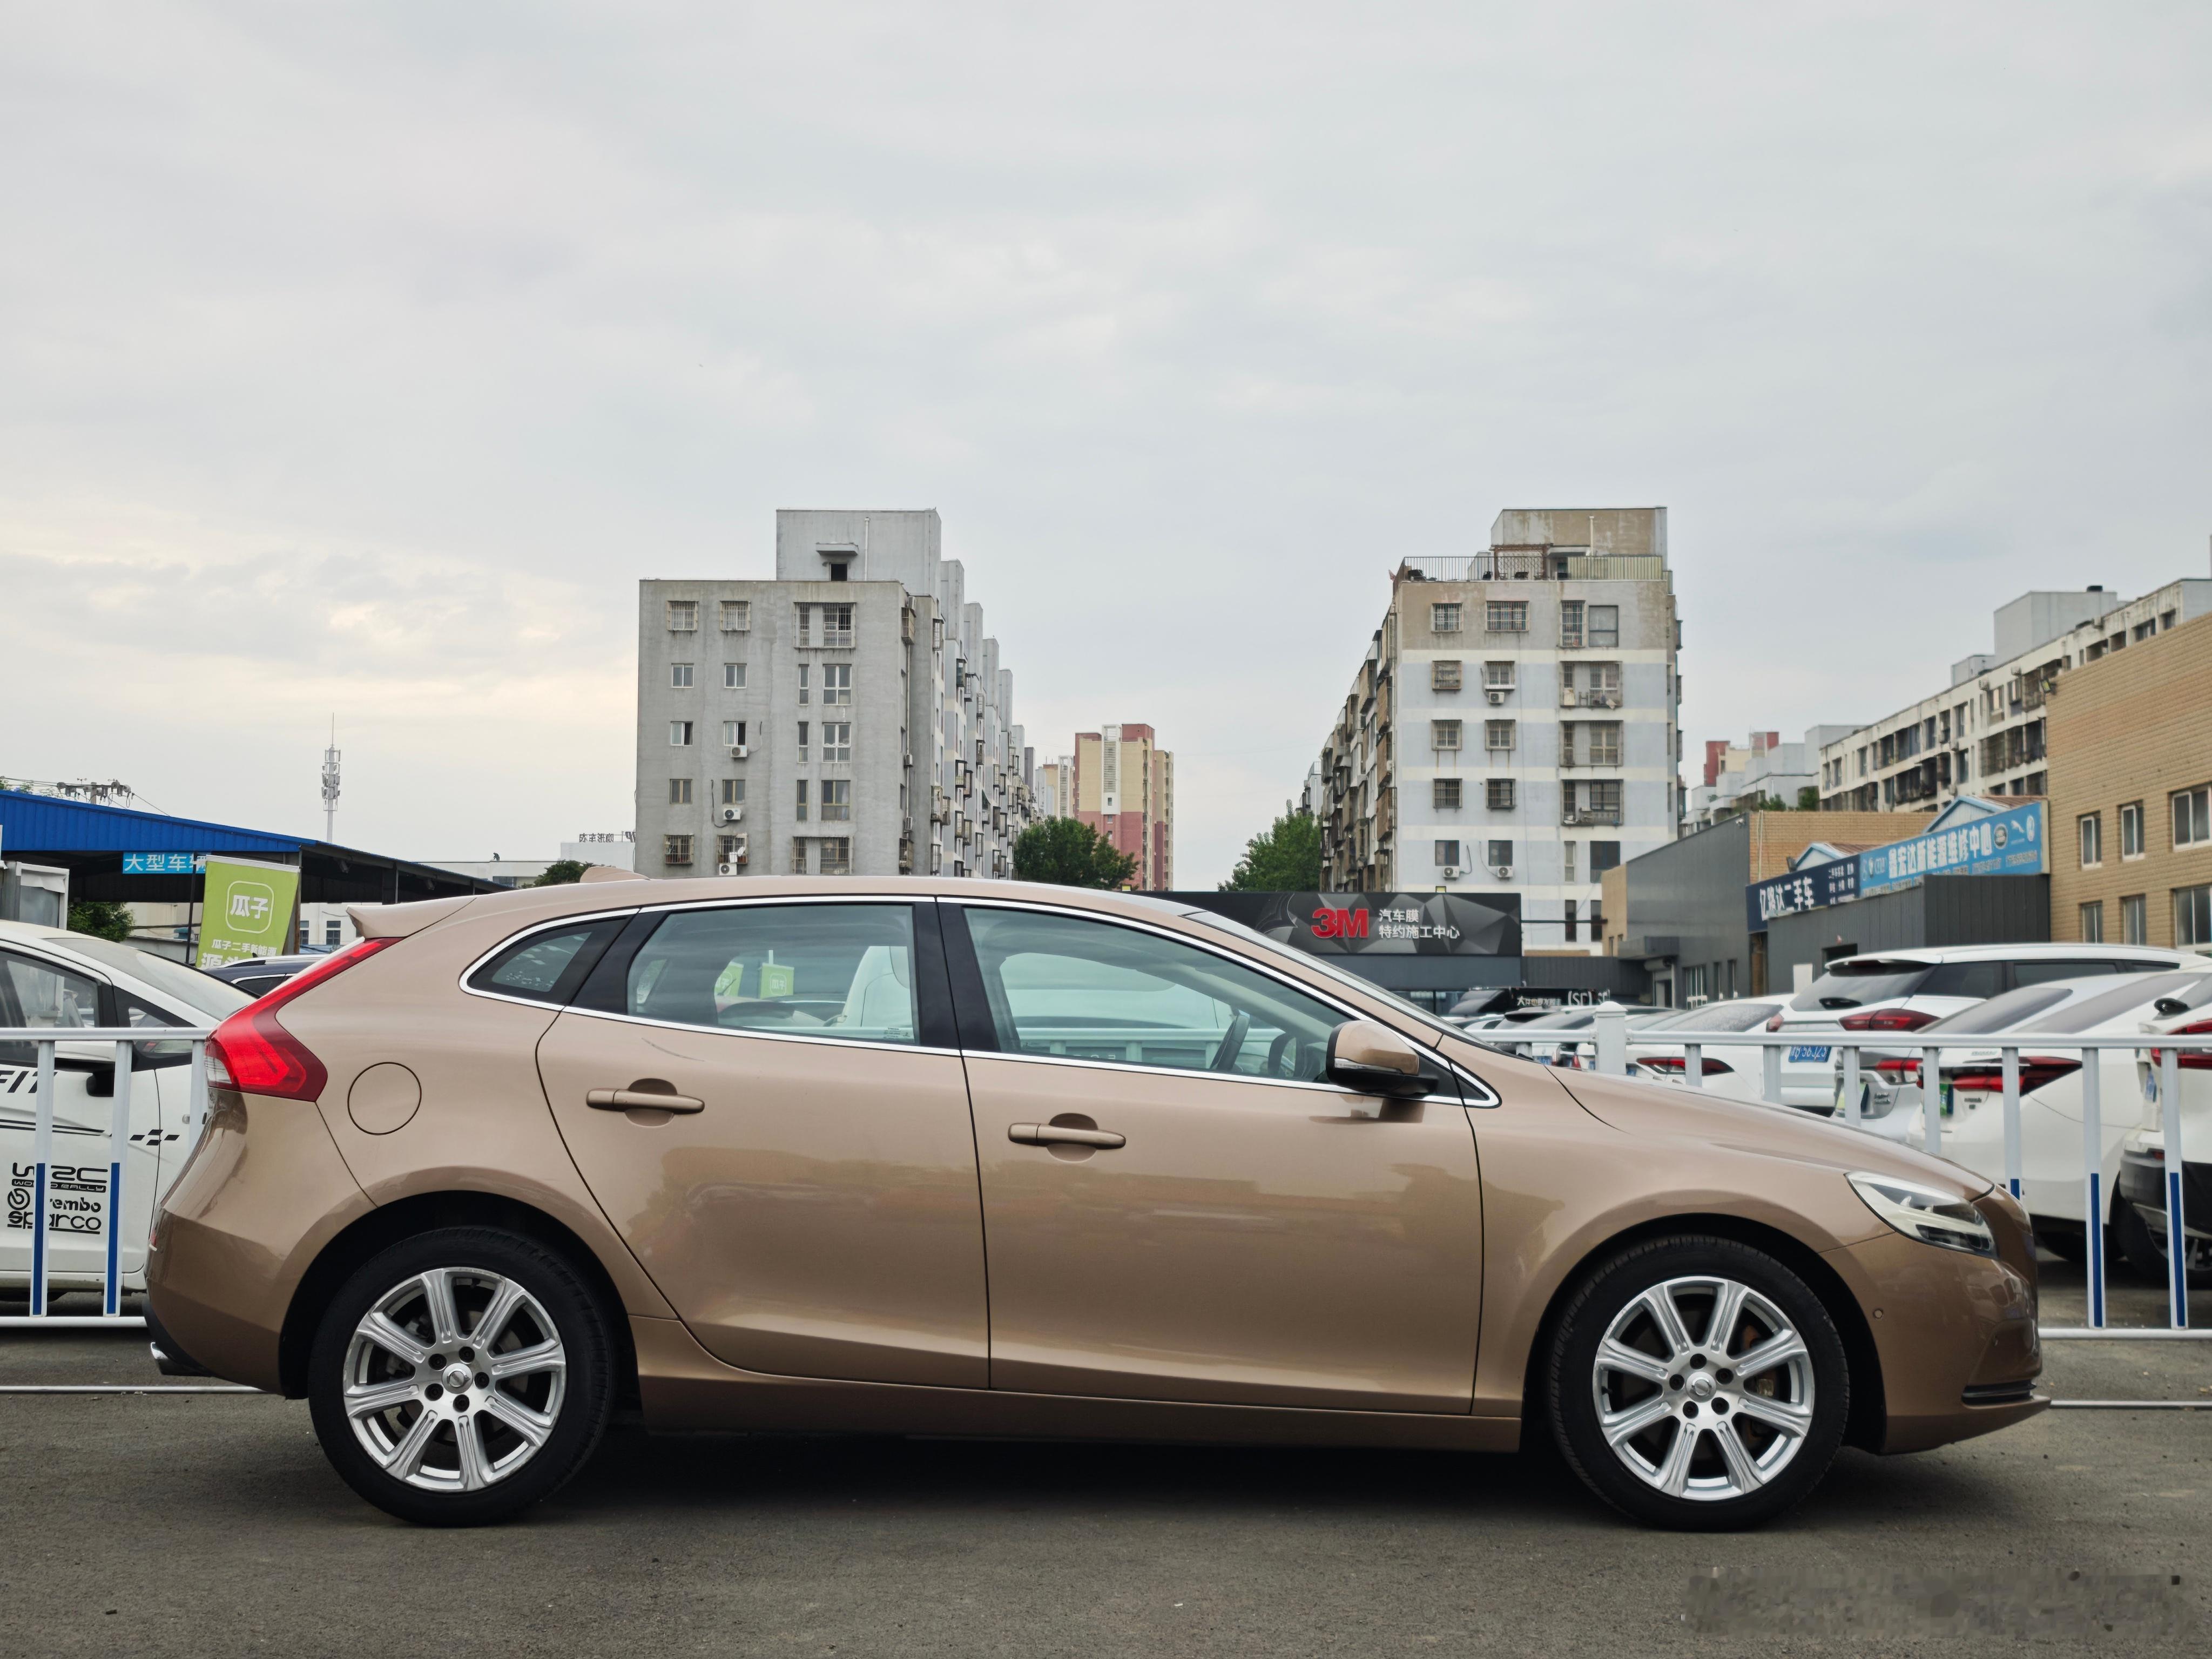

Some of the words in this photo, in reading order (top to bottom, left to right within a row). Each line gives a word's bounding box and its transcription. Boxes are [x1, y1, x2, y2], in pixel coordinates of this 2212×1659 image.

[231, 895, 268, 919] 瓜子
[1311, 908, 1369, 939] 3M
[1379, 909, 1419, 923] 汽车膜
[1379, 925, 1460, 939] 特约施工中心
[212, 939, 277, 956] 瓜子二手新能源
